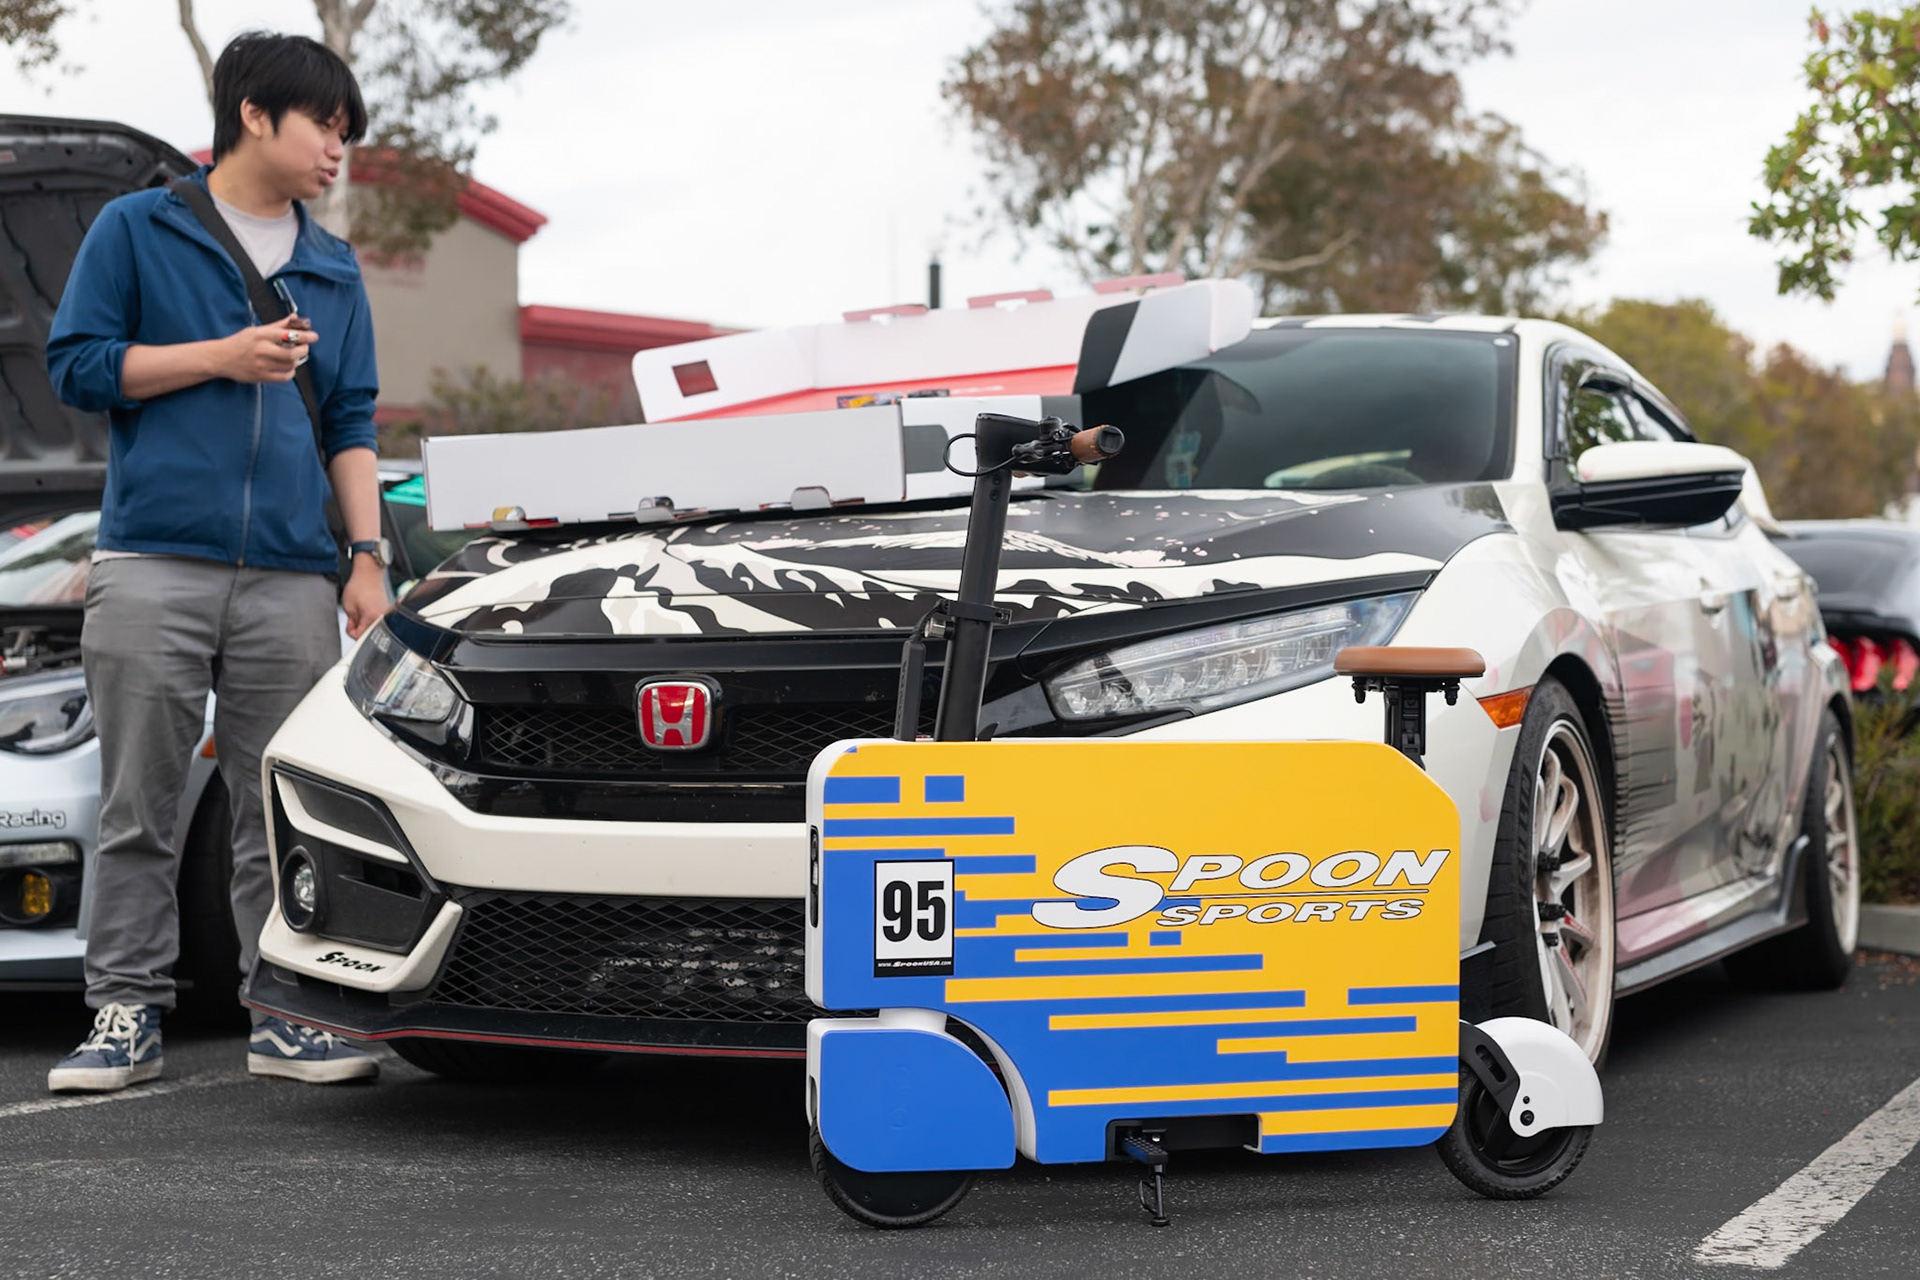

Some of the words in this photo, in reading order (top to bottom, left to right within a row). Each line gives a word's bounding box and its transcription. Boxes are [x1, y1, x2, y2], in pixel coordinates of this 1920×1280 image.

[0, 808, 66, 830] Racing
[1031, 845, 1451, 929] SPOON
[882, 880, 946, 942] 95
[1156, 898, 1424, 926] SPORTS
